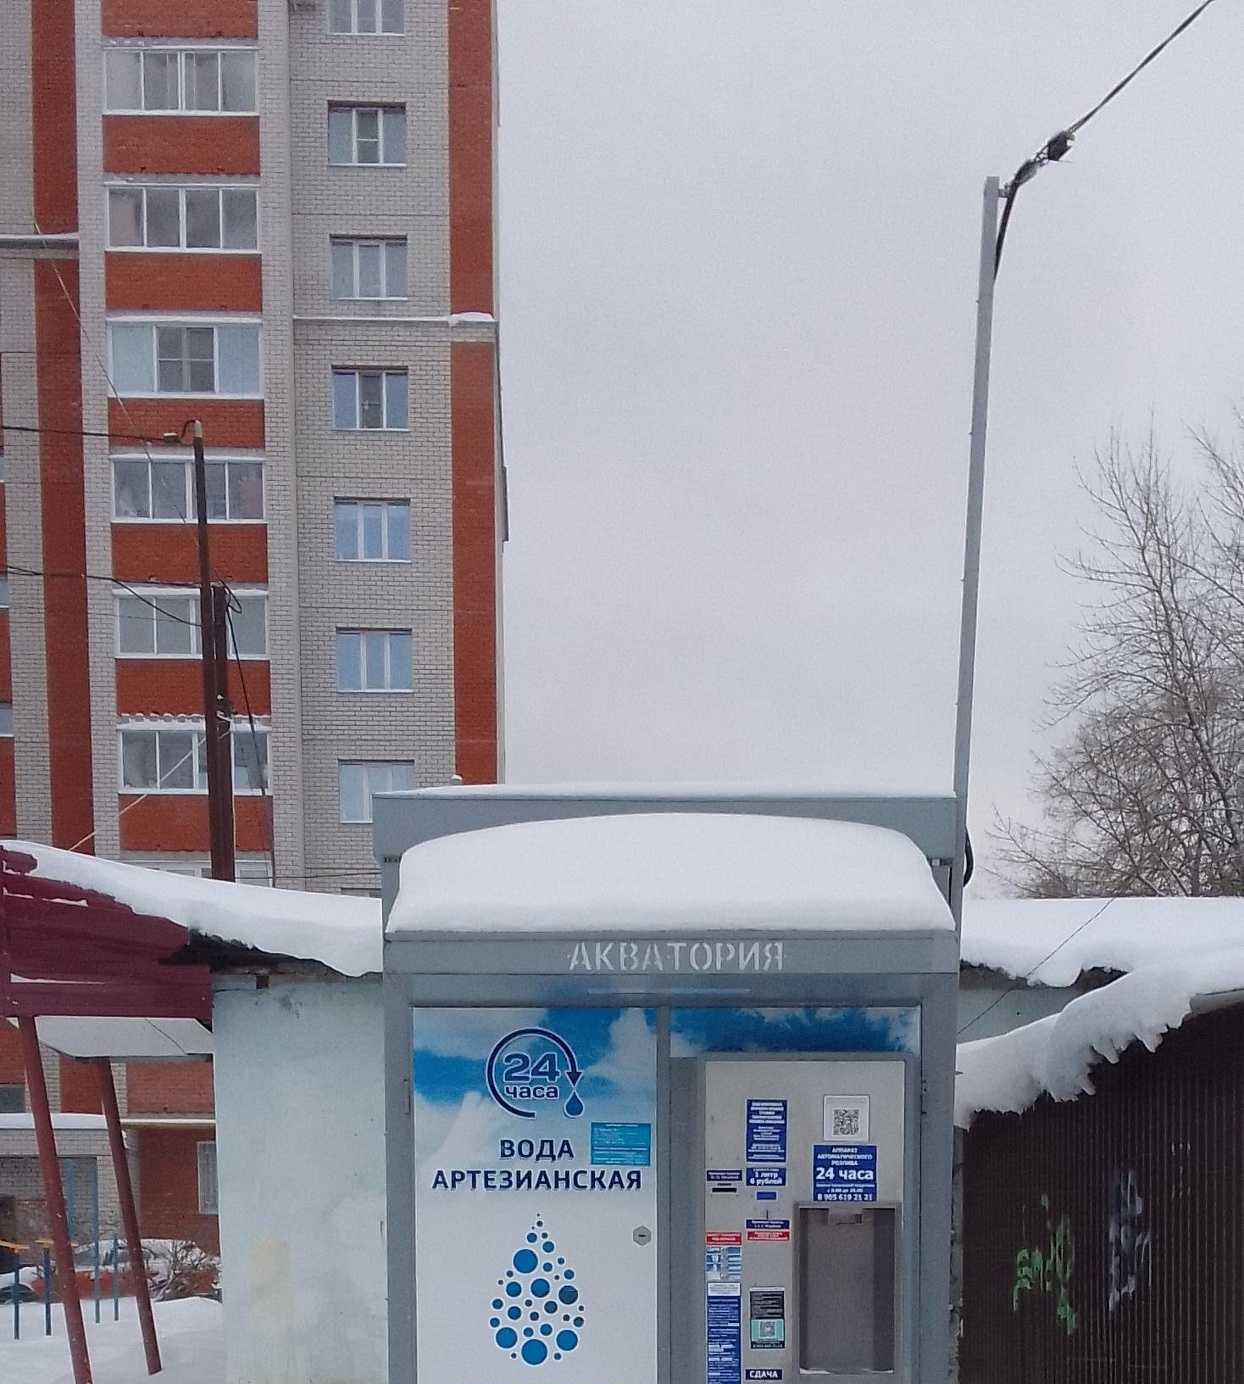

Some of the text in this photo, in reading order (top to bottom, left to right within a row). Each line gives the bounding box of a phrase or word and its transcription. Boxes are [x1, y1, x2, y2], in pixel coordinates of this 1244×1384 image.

[569, 942, 784, 971] АКВАТОРИЯ
[503, 1053, 560, 1082] 24
[505, 1086, 559, 1099] часа
[499, 1139, 574, 1161] ВОДА
[432, 1170, 642, 1190] АРТЕЗИАНСКАЯ
[816, 1167, 874, 1180] 24 часа
[749, 1370, 779, 1378] СДАЧА
